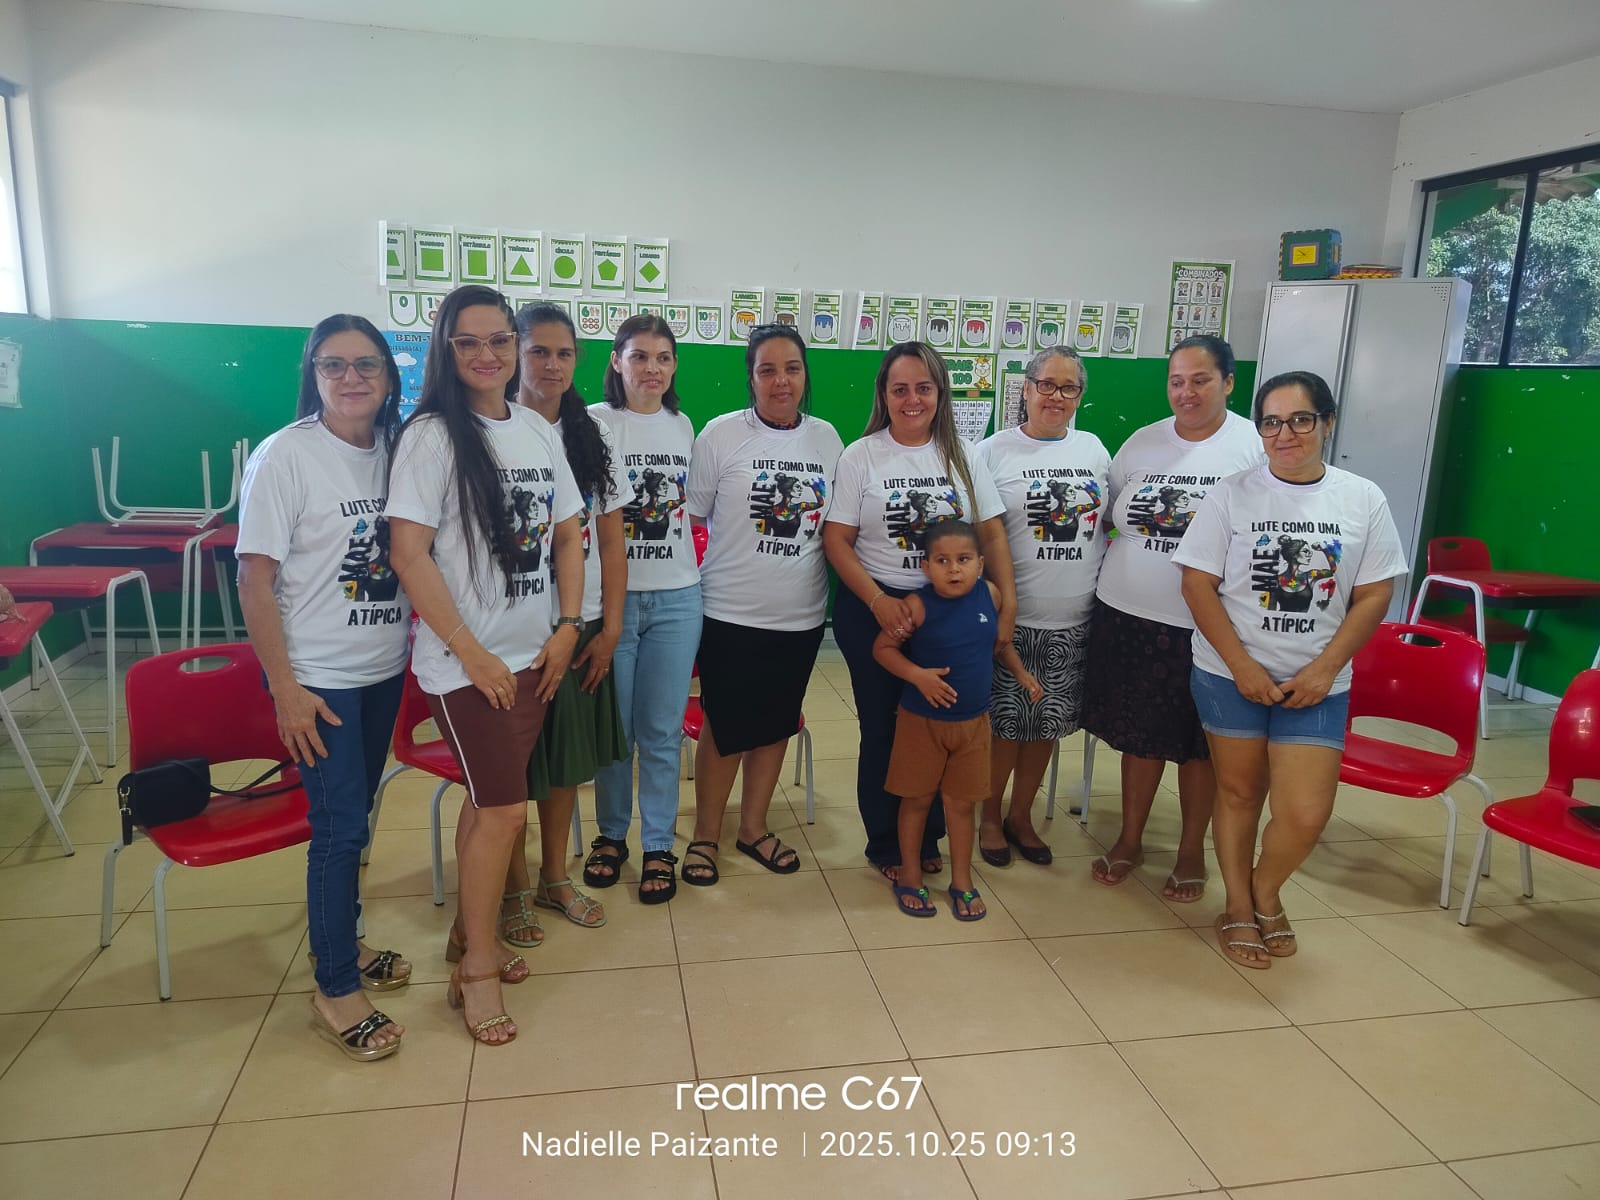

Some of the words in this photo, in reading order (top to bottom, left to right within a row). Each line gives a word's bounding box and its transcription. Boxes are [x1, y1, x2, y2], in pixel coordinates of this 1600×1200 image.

[1178, 269, 1224, 279] COMBINADOS
[399, 295, 408, 308] 0
[427, 297, 433, 309] 1
[581, 306, 590, 317] 6
[610, 306, 617, 318] 7
[669, 309, 676, 320] 9
[699, 311, 708, 321] 10
[952, 372, 973, 385] 100
[645, 454, 671, 466] COMO
[753, 459, 775, 470] LUTE
[778, 461, 804, 472] COMO
[806, 463, 824, 474] UMA
[511, 468, 539, 483] COMO
[1022, 469, 1046, 478] LUTE
[1048, 468, 1073, 478] COMO
[1074, 468, 1094, 478] UMA
[1142, 474, 1167, 484] LUTE
[1168, 475, 1197, 485] COMO
[884, 478, 907, 489] LUTE
[909, 477, 935, 488] COMO
[340, 499, 374, 517] LUTE
[747, 482, 776, 519] MÃE
[1023, 491, 1051, 526] MÃE
[1125, 494, 1158, 525] MÃE
[882, 502, 910, 538] MÃE
[1251, 520, 1279, 532] LUTE
[1282, 521, 1314, 533] COMO
[1318, 522, 1341, 536] UMA
[627, 542, 673, 559] ATÍPICA
[756, 538, 801, 557] ATÍPICA
[1036, 544, 1083, 560] ATÍPICA
[1249, 548, 1280, 591] MÃE
[348, 604, 402, 626] ATÍPICA
[1261, 614, 1316, 633] ATÍPICA
